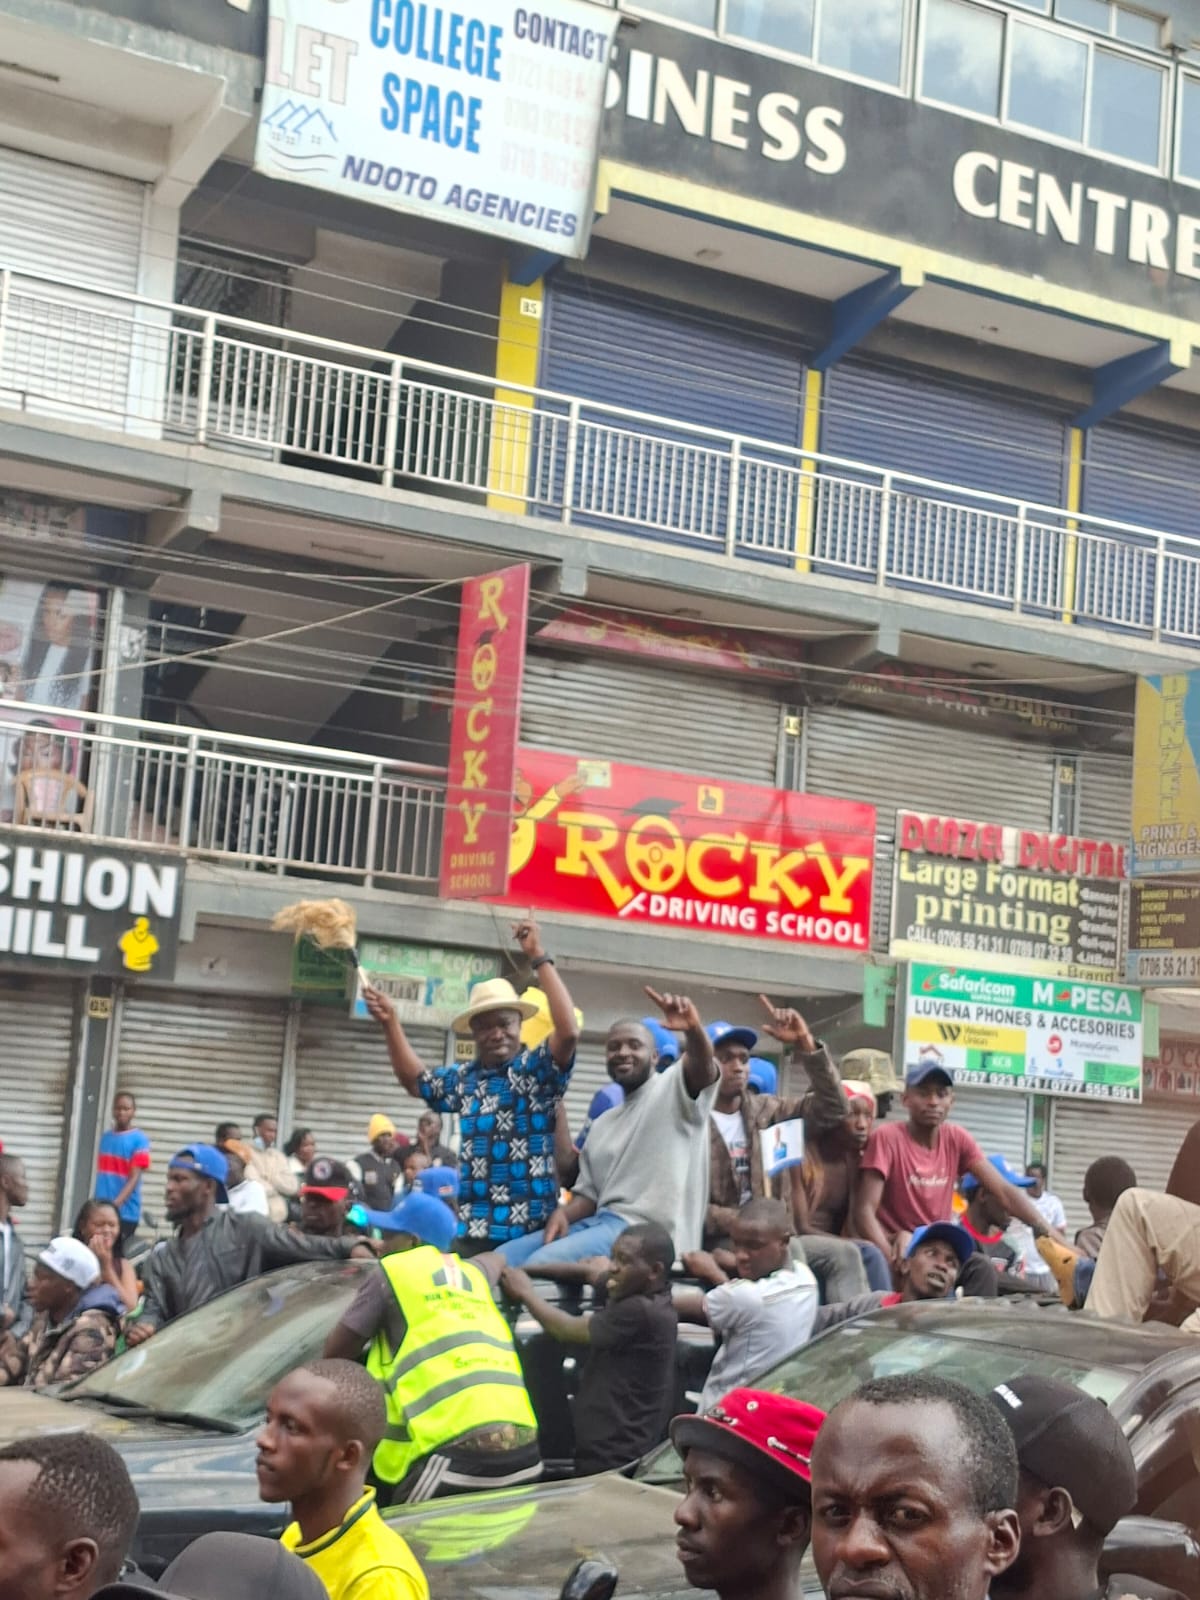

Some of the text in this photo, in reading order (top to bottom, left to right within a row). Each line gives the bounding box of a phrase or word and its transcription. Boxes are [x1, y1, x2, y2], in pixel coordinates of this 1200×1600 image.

[265, 16, 359, 106] LET
[369, 0, 503, 82] COLLEGE
[513, 8, 608, 63] CONTACT
[380, 72, 482, 154] SPACE
[341, 155, 577, 237] NDOTO AGENCIES
[953, 150, 1200, 281] CENTRE
[459, 577, 508, 844] ROCKY
[1018, 831, 1128, 880] DIGITAL
[1141, 822, 1199, 841] PRINT &
[450, 851, 496, 869] DRIVING
[450, 872, 493, 890] SCHOOL
[555, 810, 870, 914] ROCKY
[900, 850, 1080, 908] Large Format
[649, 895, 866, 945] DRIVING SCHOOL
[914, 892, 1072, 947] printing
[939, 973, 1016, 997] Safaricom
[1176, 955, 1187, 976] 21
[914, 999, 1135, 1040] LUVENA PHONES & ACCESORIES
